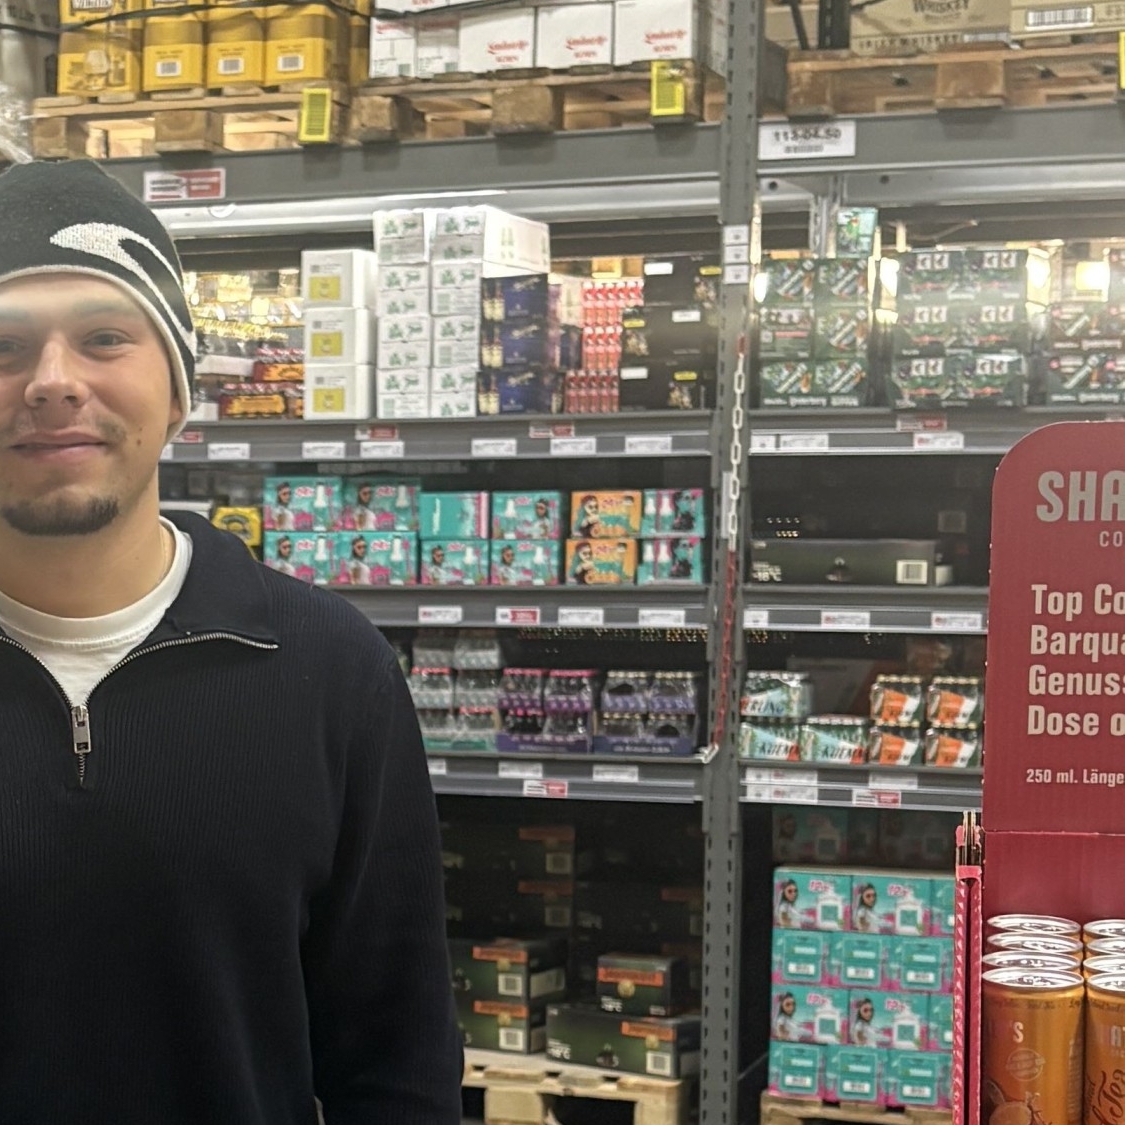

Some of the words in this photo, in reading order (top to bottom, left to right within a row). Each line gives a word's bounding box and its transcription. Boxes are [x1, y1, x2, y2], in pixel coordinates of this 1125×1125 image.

[1099, 530, 1124, 548] CO
[1031, 584, 1083, 621] Top
[1027, 704, 1100, 736] Dose
[1026, 768, 1052, 784] 250
[1056, 768, 1079, 784] ml.
